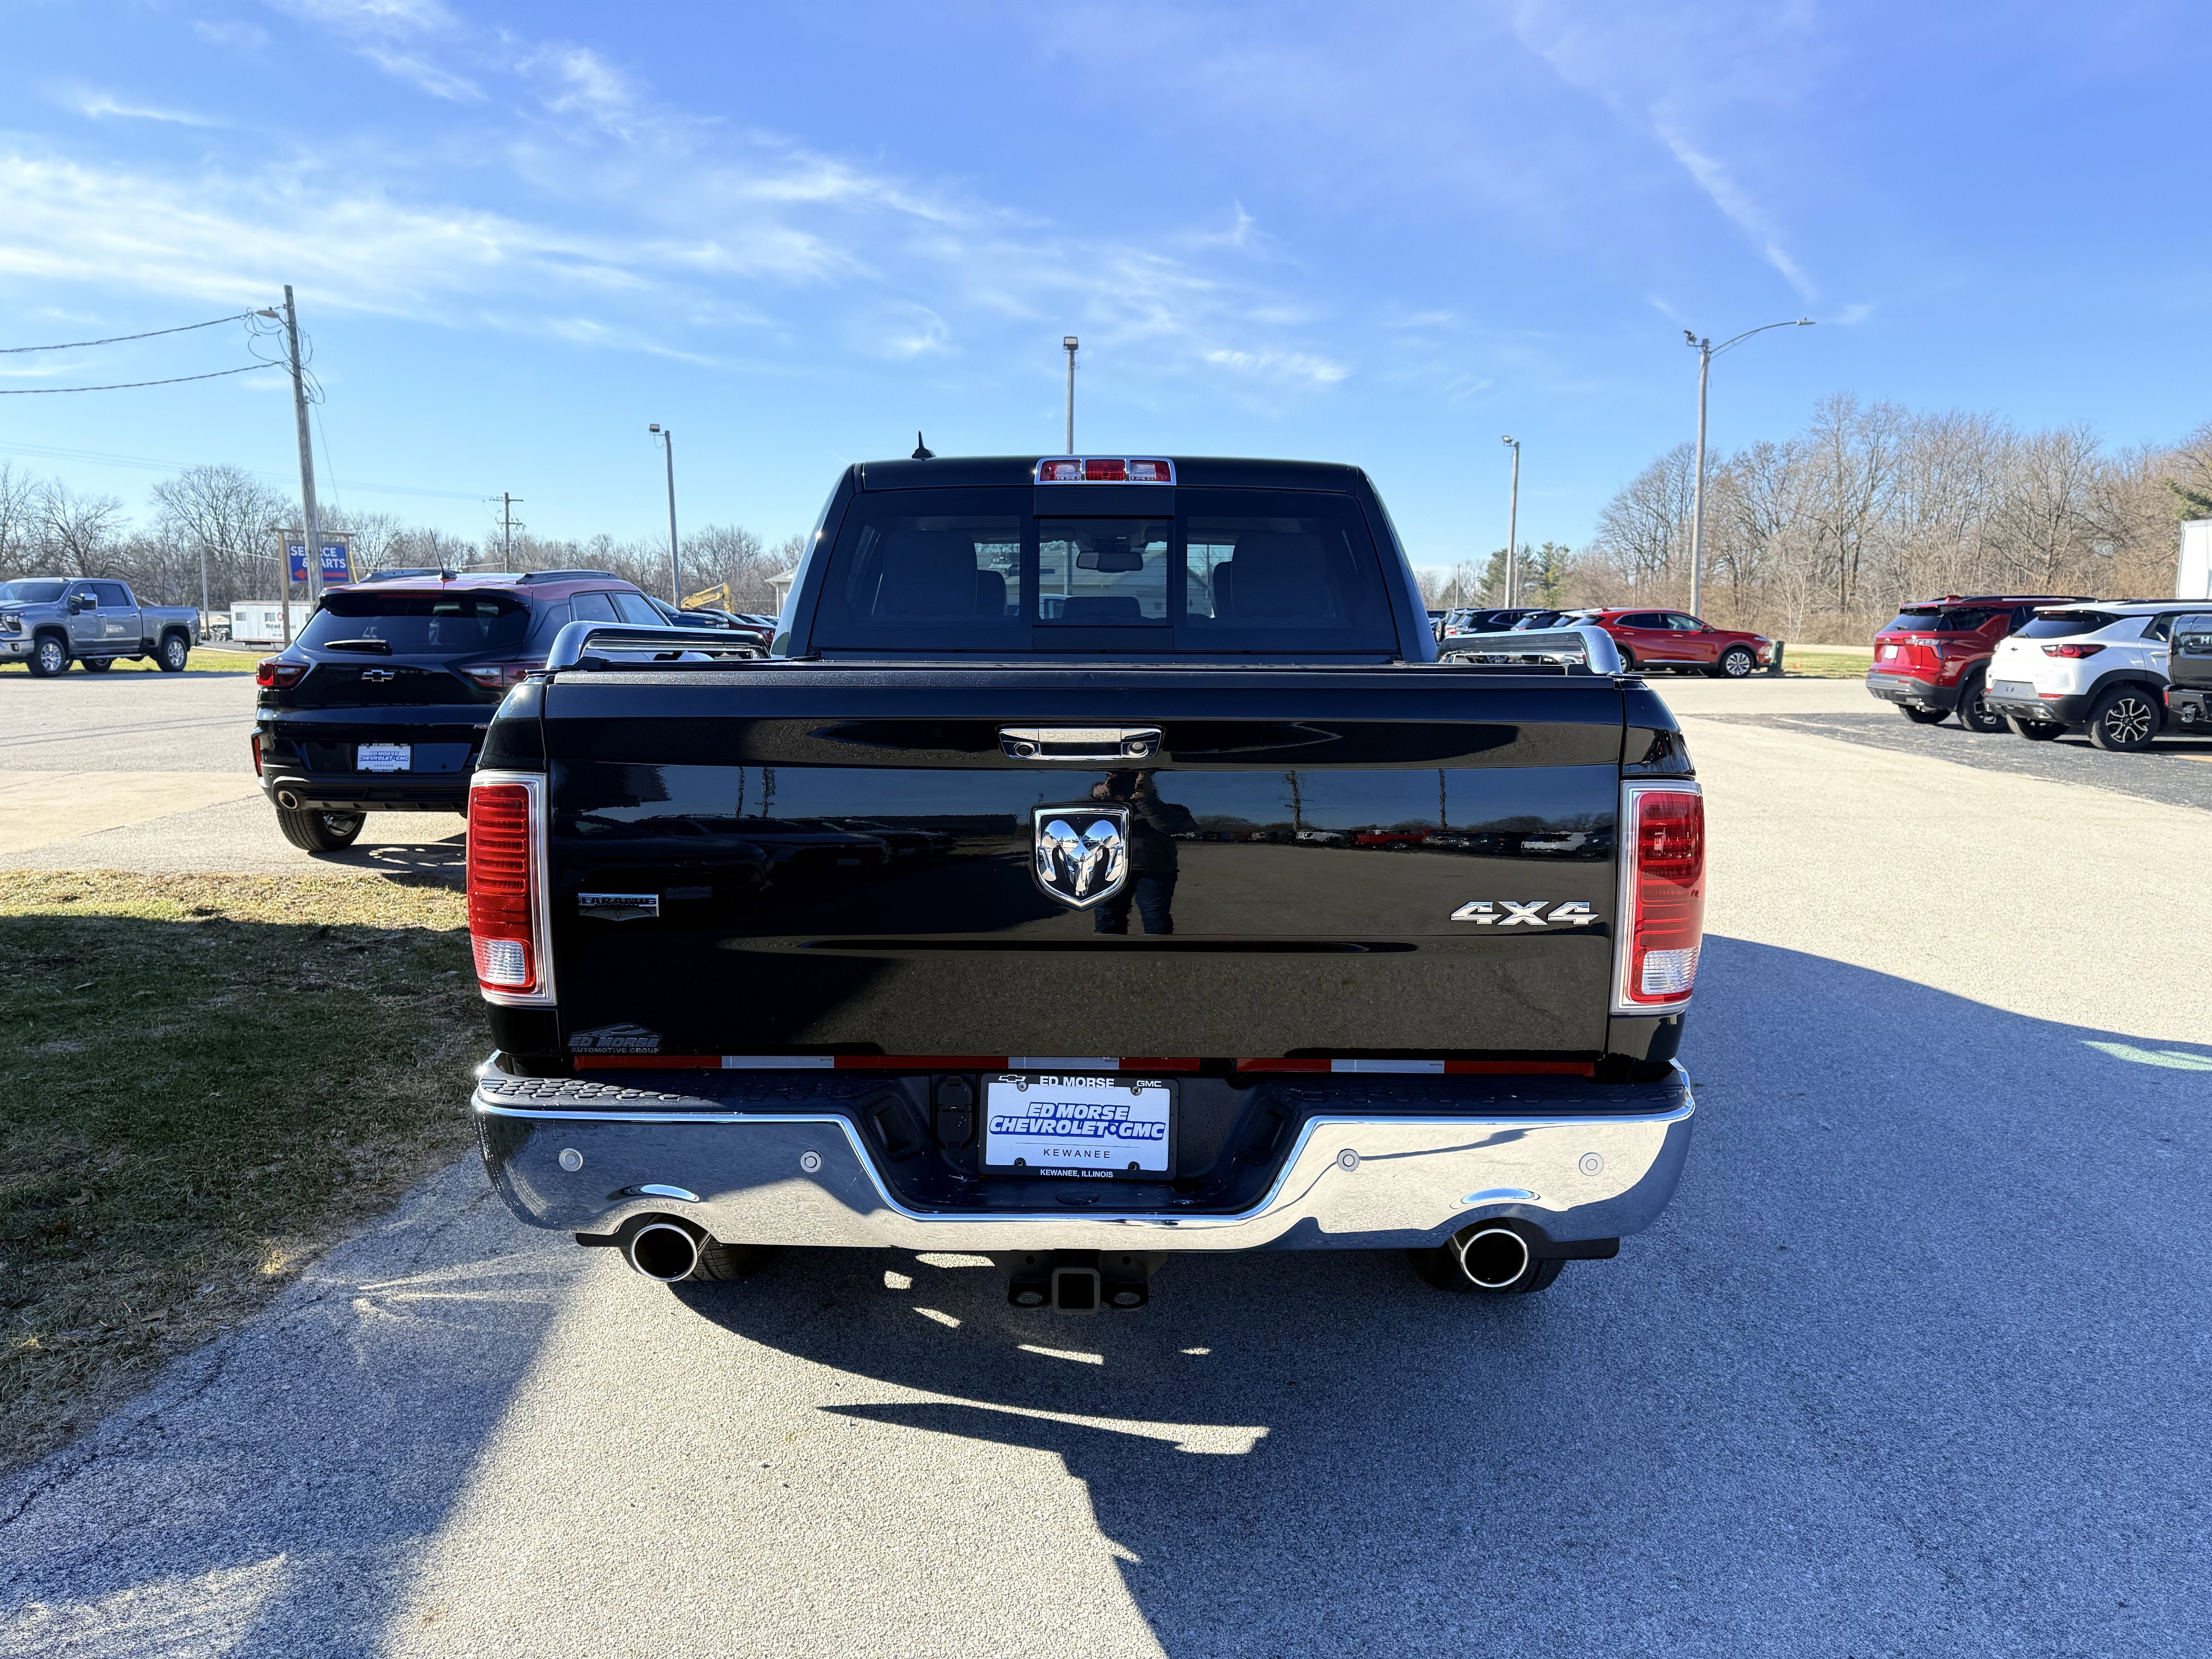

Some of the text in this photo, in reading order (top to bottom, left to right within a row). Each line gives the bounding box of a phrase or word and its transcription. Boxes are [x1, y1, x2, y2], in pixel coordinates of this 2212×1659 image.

[290, 545, 337, 557] SEICE
[321, 558, 346, 568] ARTS
[1451, 901, 1599, 925] 4X4
[568, 1037, 660, 1047] ED MORSE
[1040, 1076, 1115, 1088] ED MORSE
[1027, 1103, 1129, 1120] ED MORSE
[1044, 1149, 1110, 1158] KEWANEE
[1040, 1169, 1113, 1178] KEWANEE, ILLINOIS
